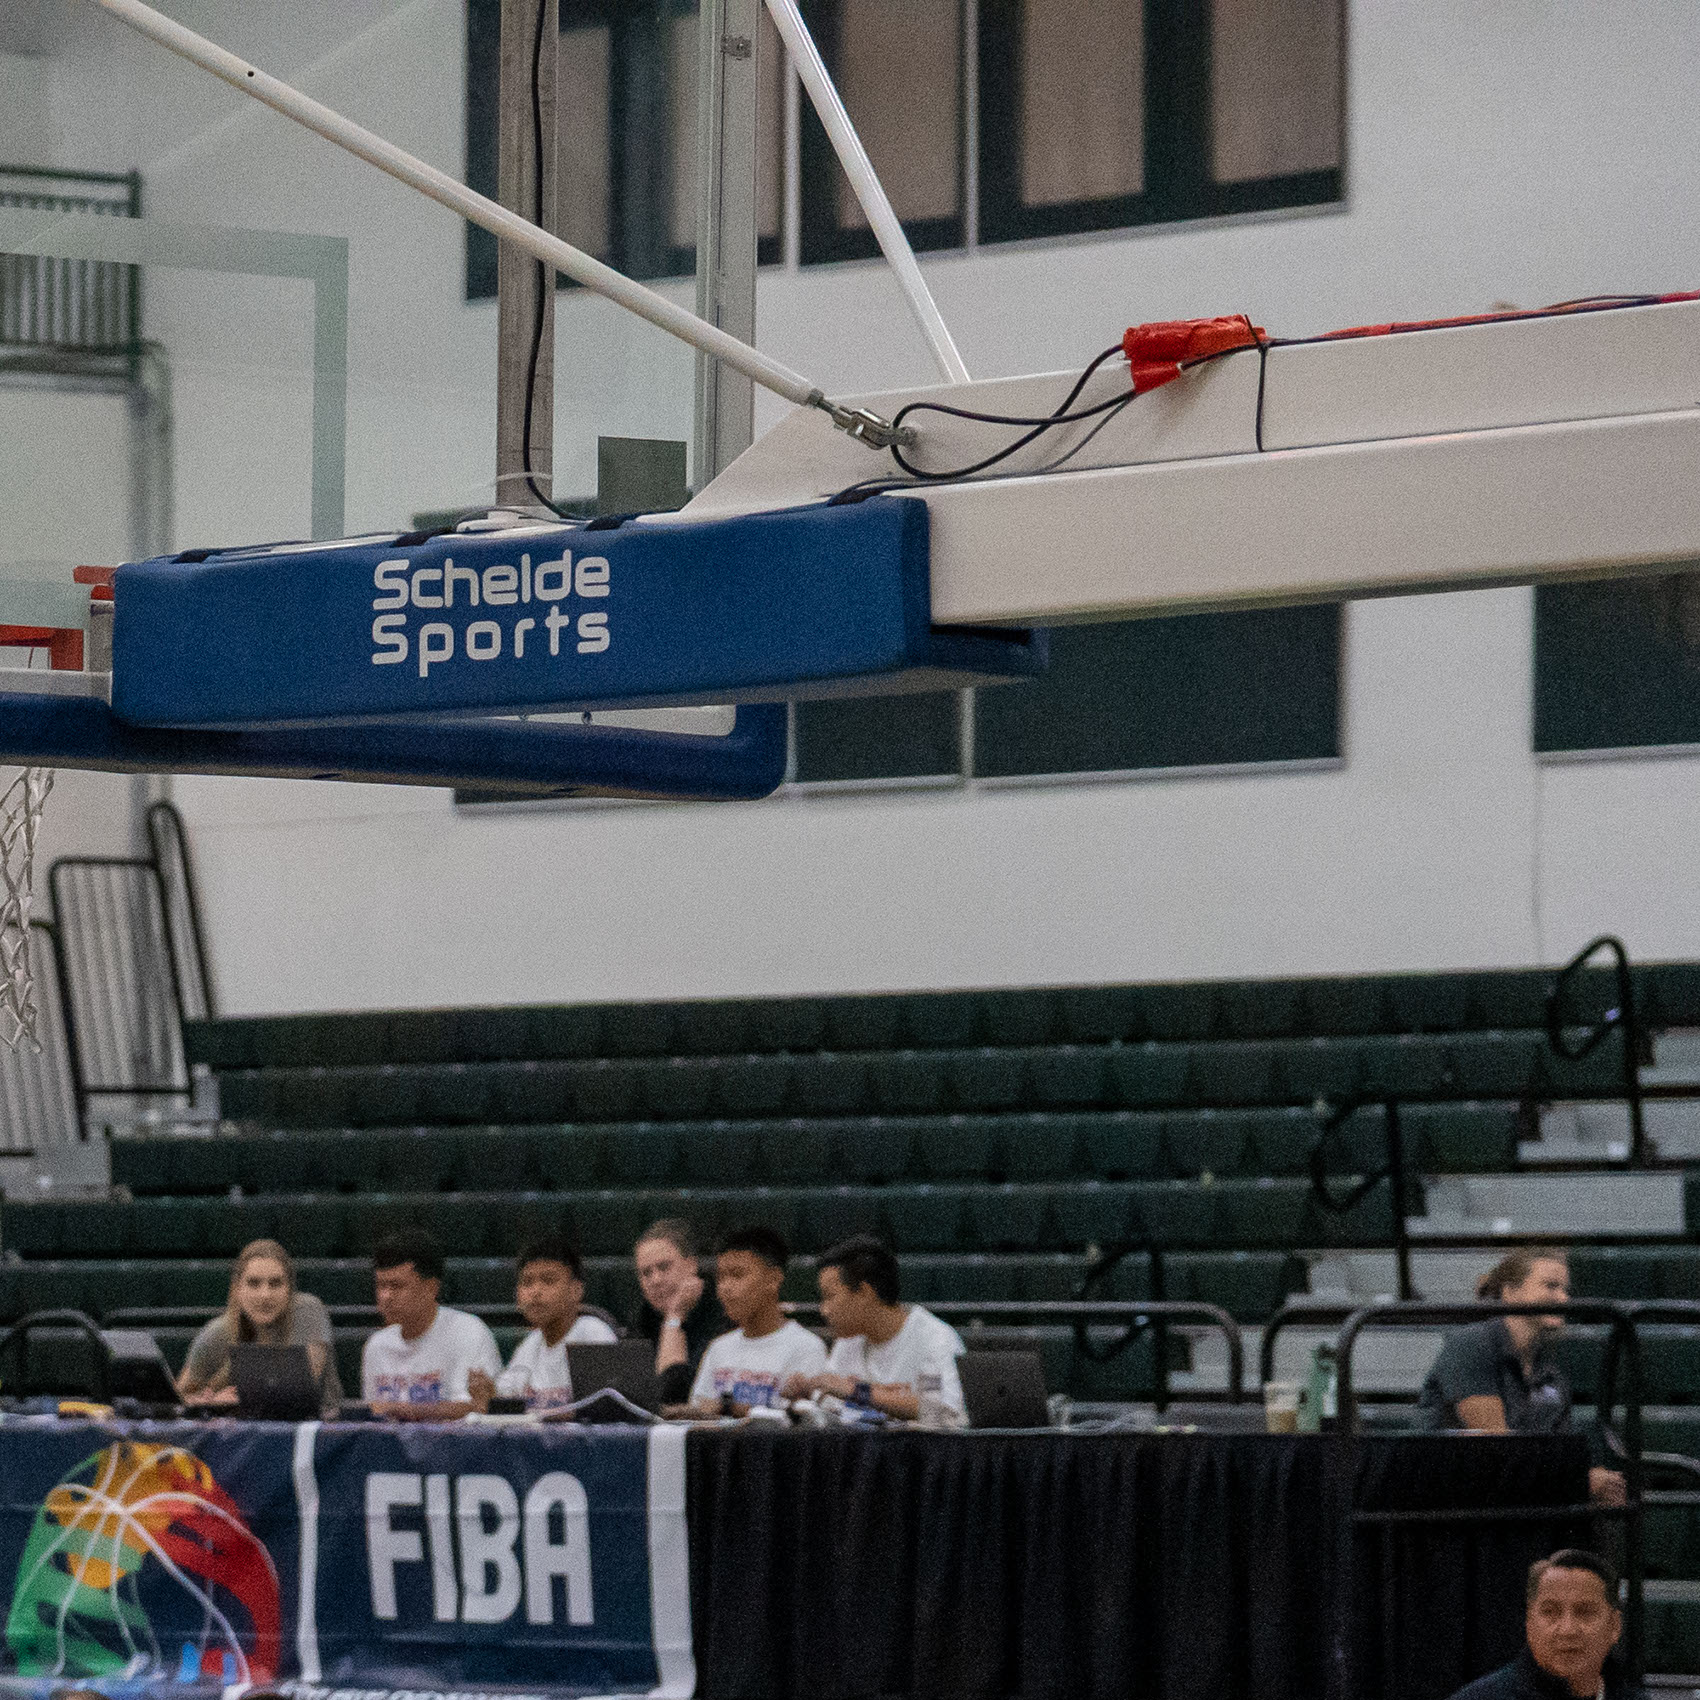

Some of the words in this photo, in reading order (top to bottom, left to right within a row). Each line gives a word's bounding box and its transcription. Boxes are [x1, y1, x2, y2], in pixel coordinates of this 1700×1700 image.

[373, 550, 610, 610] Schelde
[372, 604, 610, 677] Sports
[365, 1470, 595, 1626] FIBA
